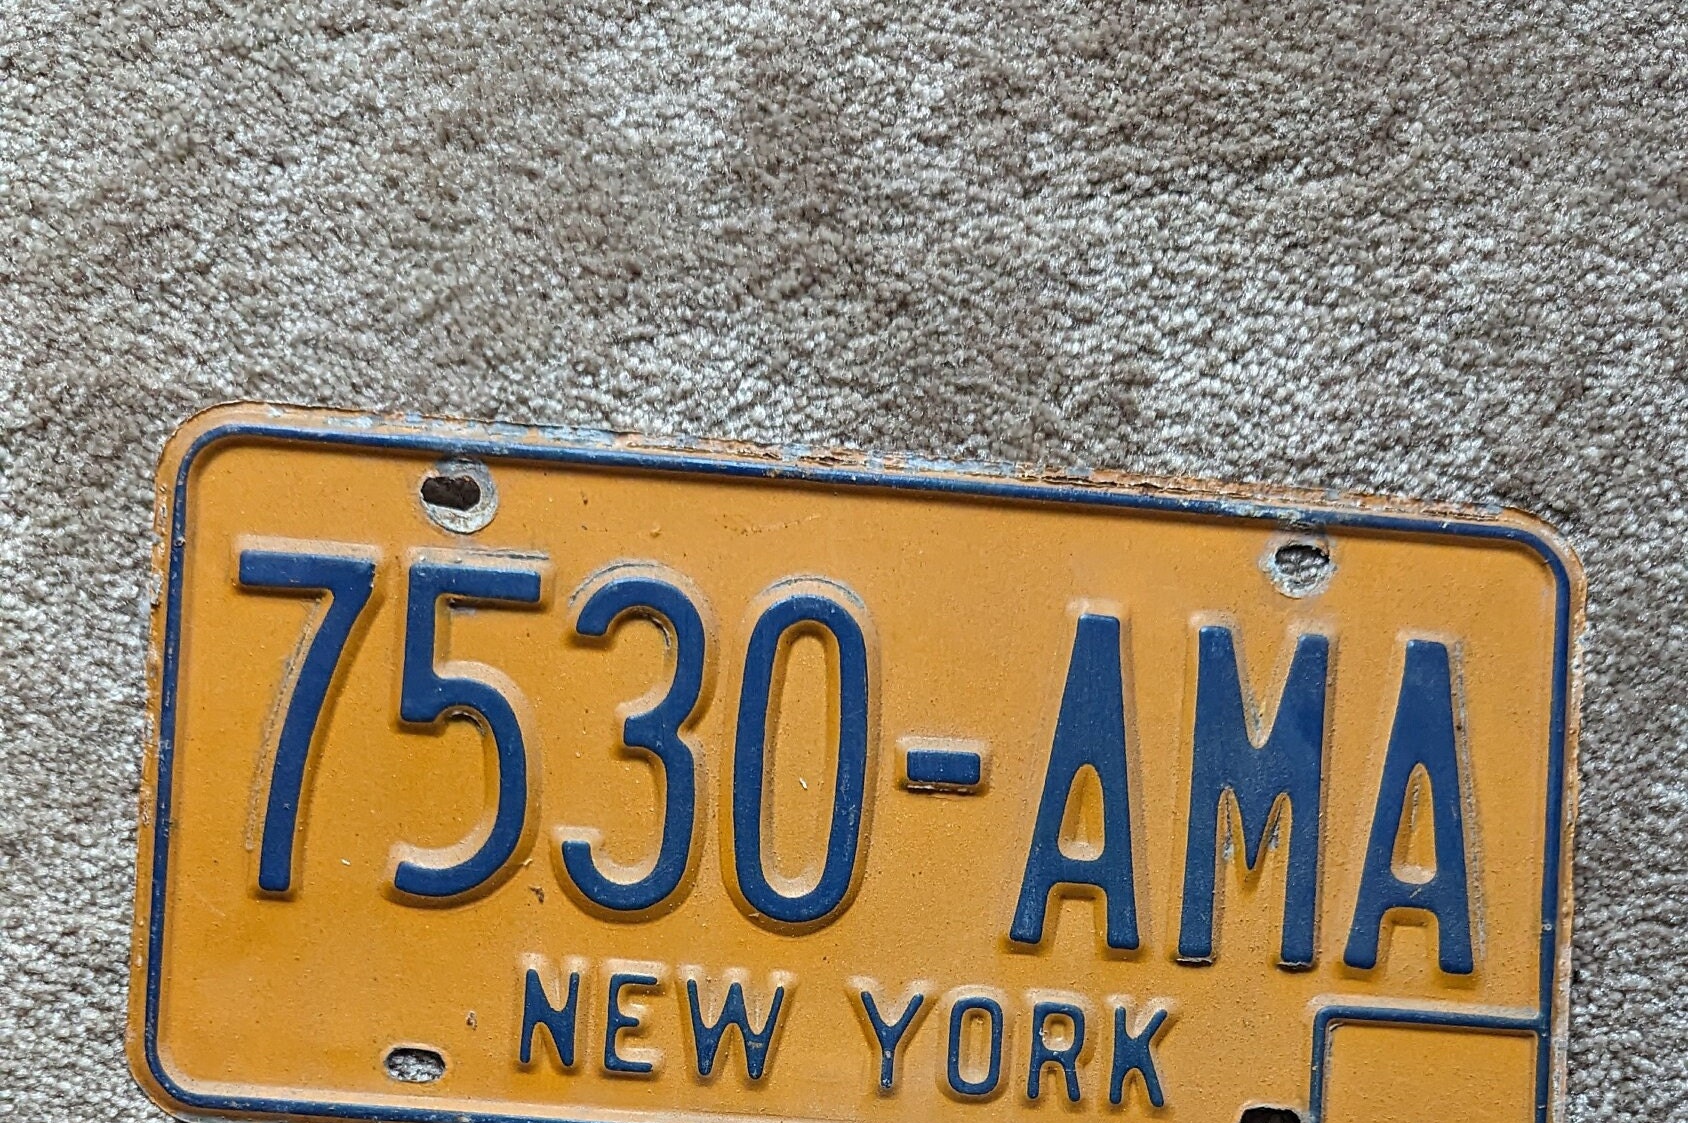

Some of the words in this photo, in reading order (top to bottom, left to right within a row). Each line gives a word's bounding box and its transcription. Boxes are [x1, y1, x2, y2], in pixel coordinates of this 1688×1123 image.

[239, 549, 1474, 975] 7530-AMA
[519, 968, 784, 1080] NEW
[860, 990, 1167, 1108] YORK
